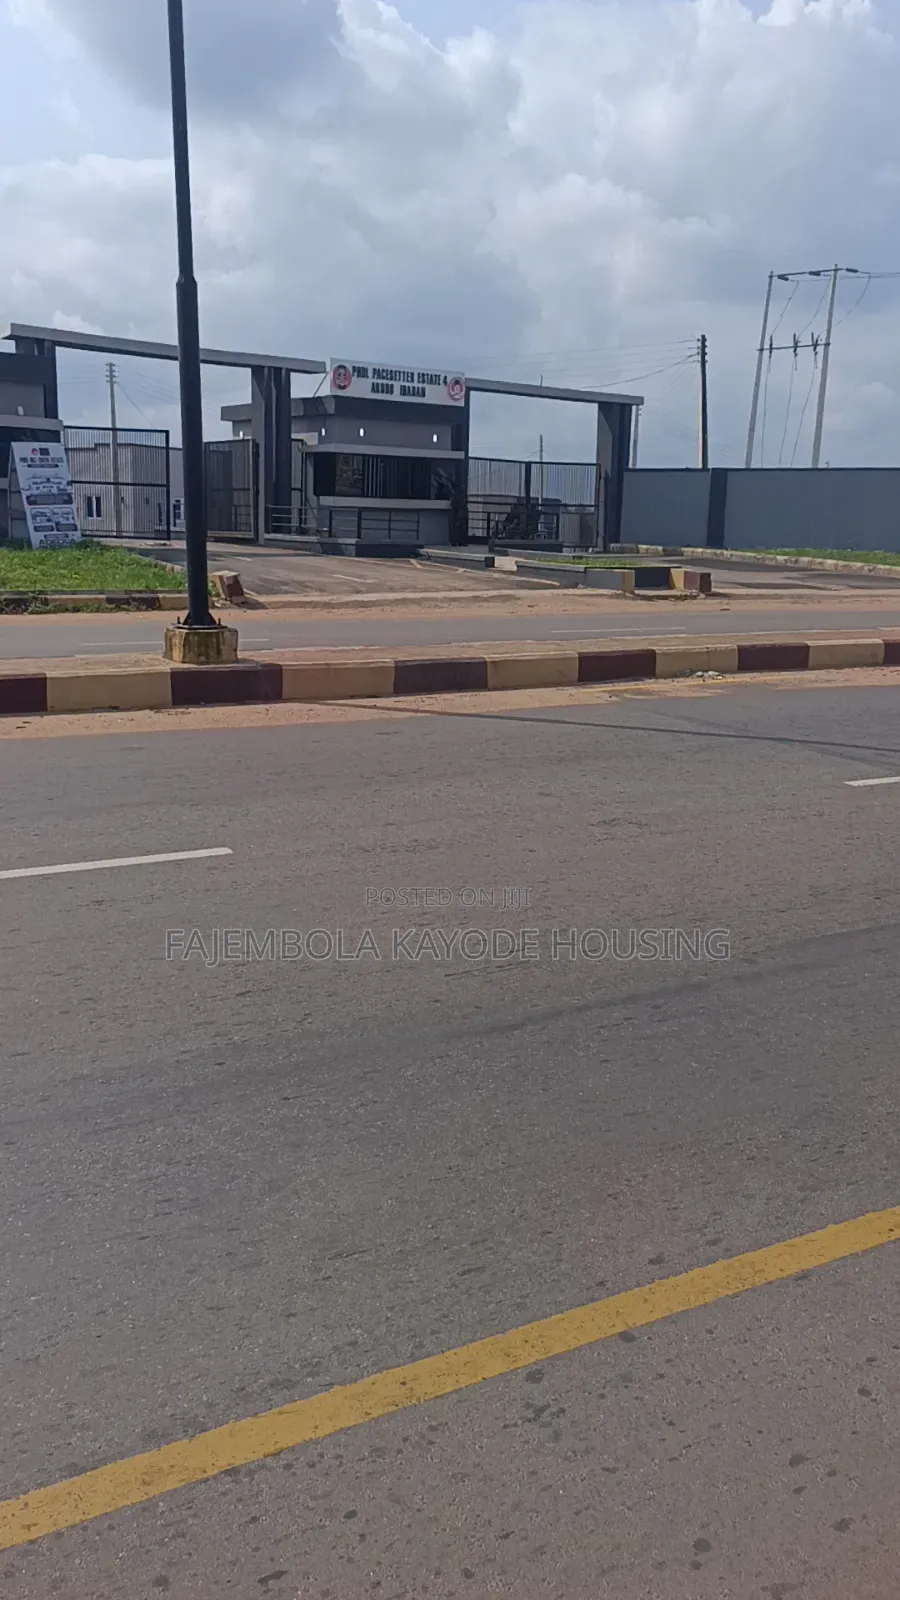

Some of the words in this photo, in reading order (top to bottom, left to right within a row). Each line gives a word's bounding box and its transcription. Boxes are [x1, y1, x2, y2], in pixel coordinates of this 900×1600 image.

[372, 367, 414, 383] PACESETTER
[418, 372, 441, 385] ESTATE
[400, 385, 426, 397] IBADAN
